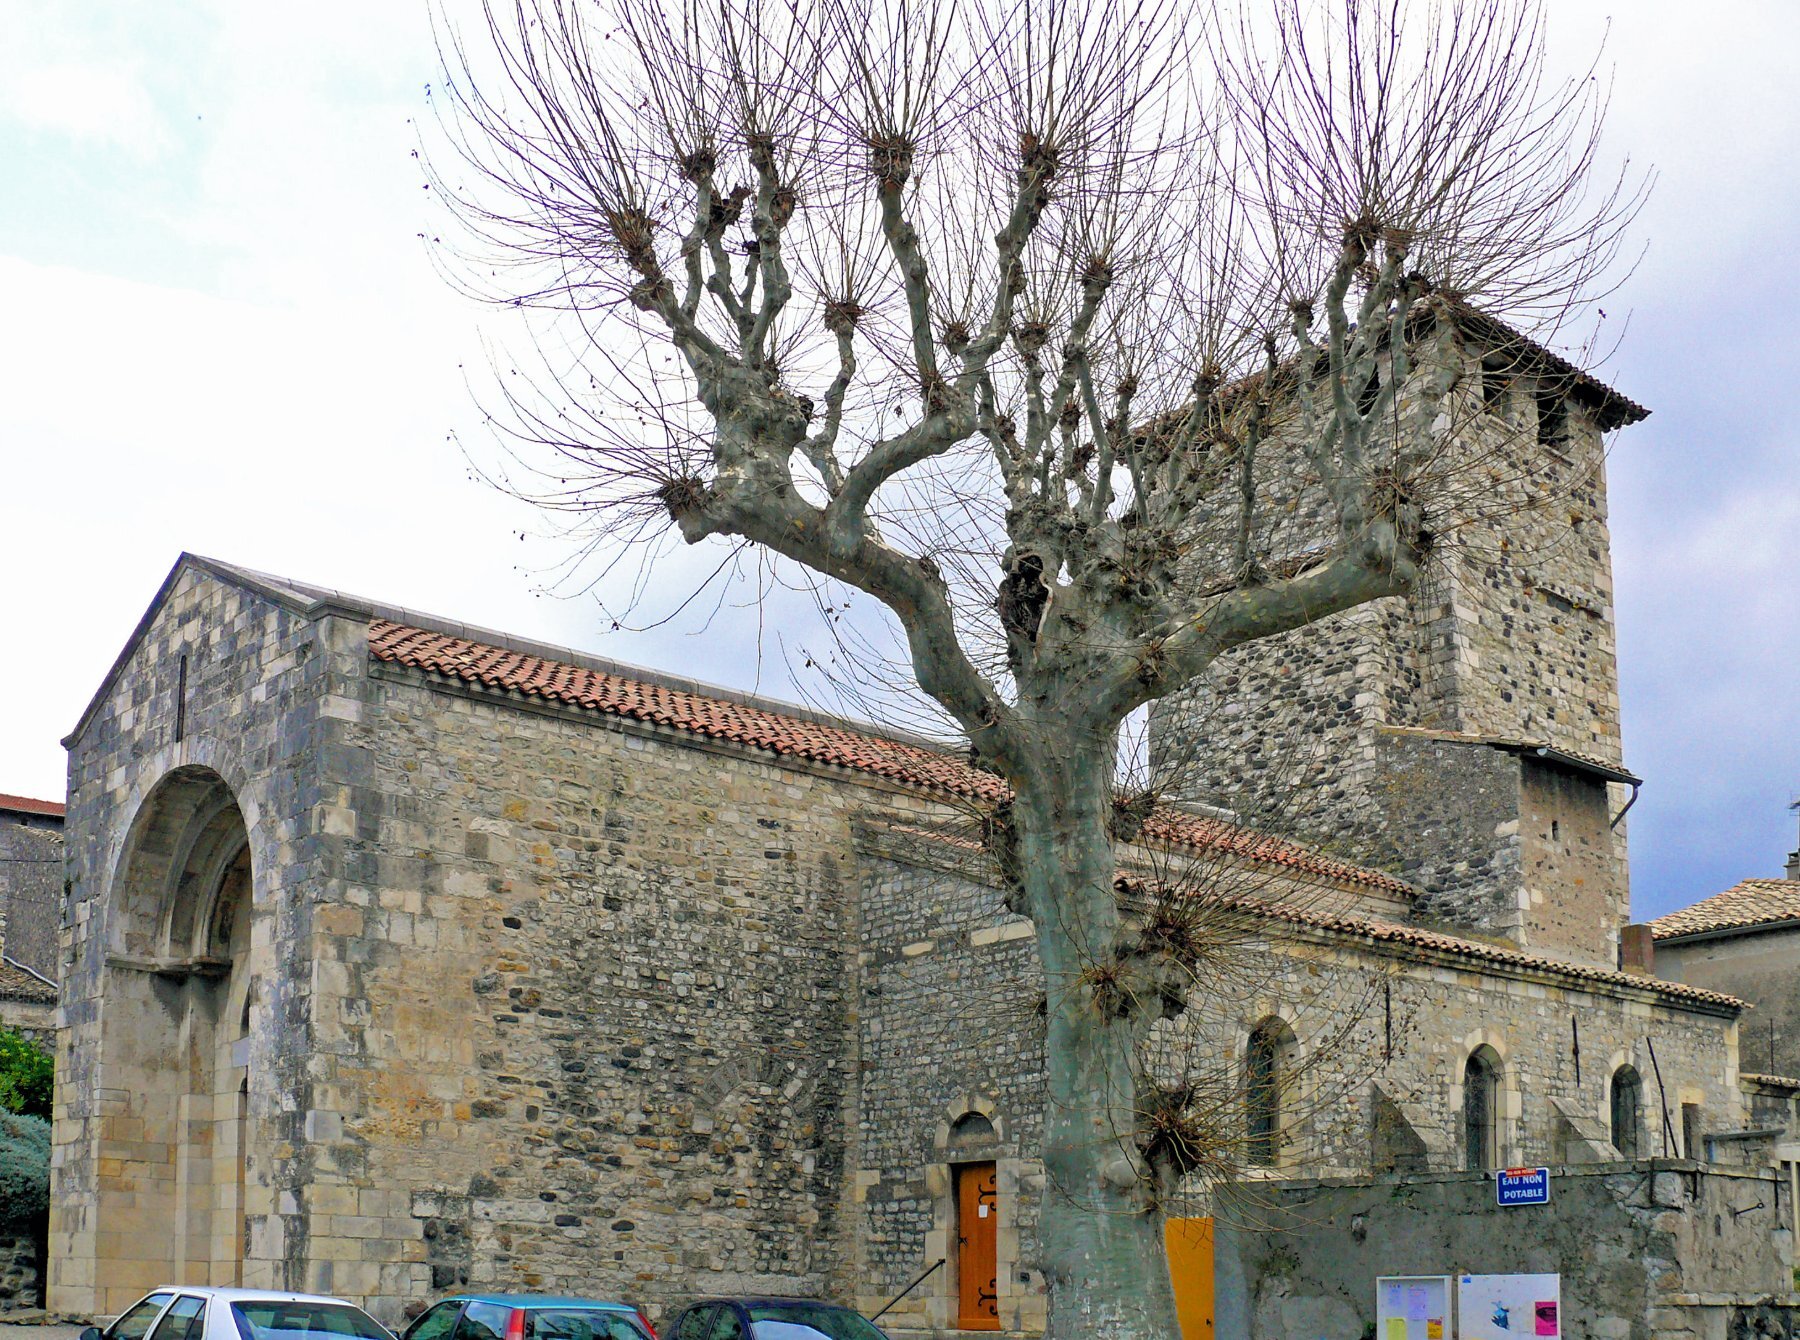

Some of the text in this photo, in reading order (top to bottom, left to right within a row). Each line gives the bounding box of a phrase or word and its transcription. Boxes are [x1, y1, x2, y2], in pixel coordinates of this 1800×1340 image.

[1502, 1175, 1542, 1185] EAU NON
[1503, 1189, 1543, 1199] POTABLE
